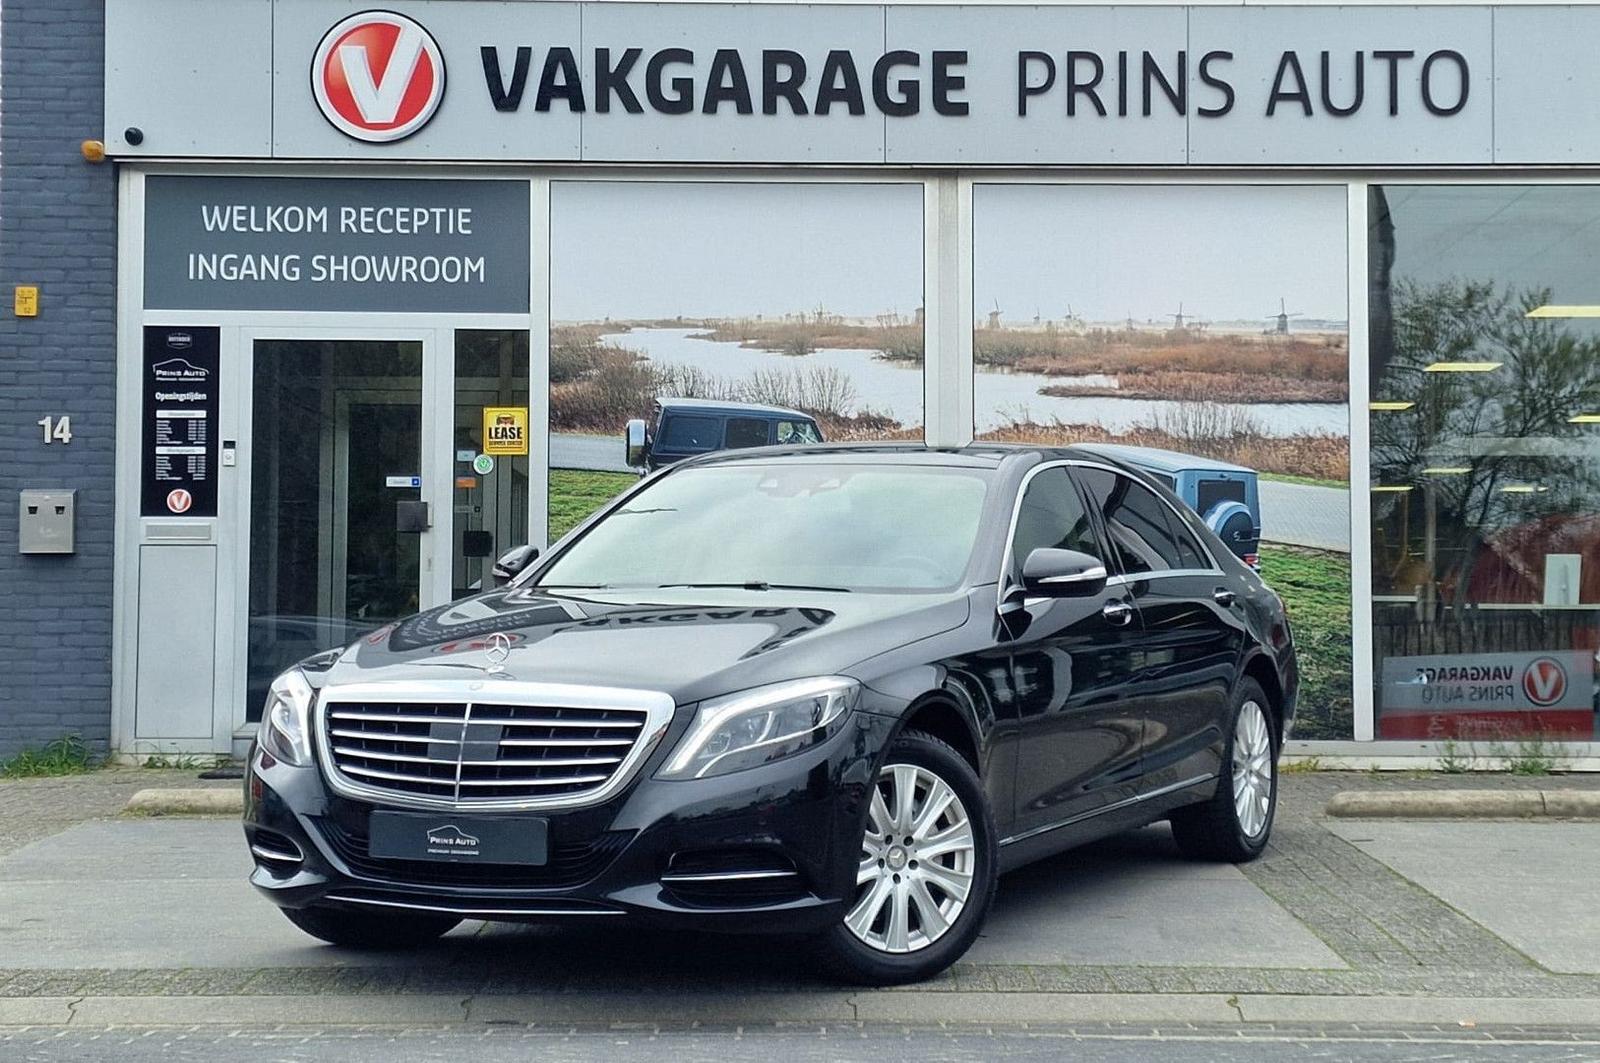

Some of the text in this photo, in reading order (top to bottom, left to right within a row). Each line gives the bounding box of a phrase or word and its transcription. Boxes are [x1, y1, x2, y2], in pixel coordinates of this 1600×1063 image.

[480, 46, 1471, 117] VAKGARAGE PRINS AUTO
[202, 205, 472, 235] WELKOM RECEPTIE
[188, 253, 485, 283] INGANG SHOWROOM
[155, 391, 207, 402] Openingstijden
[38, 416, 72, 444] 14
[489, 427, 523, 440] LEASE
[430, 836, 476, 846] PRINS AUTO
